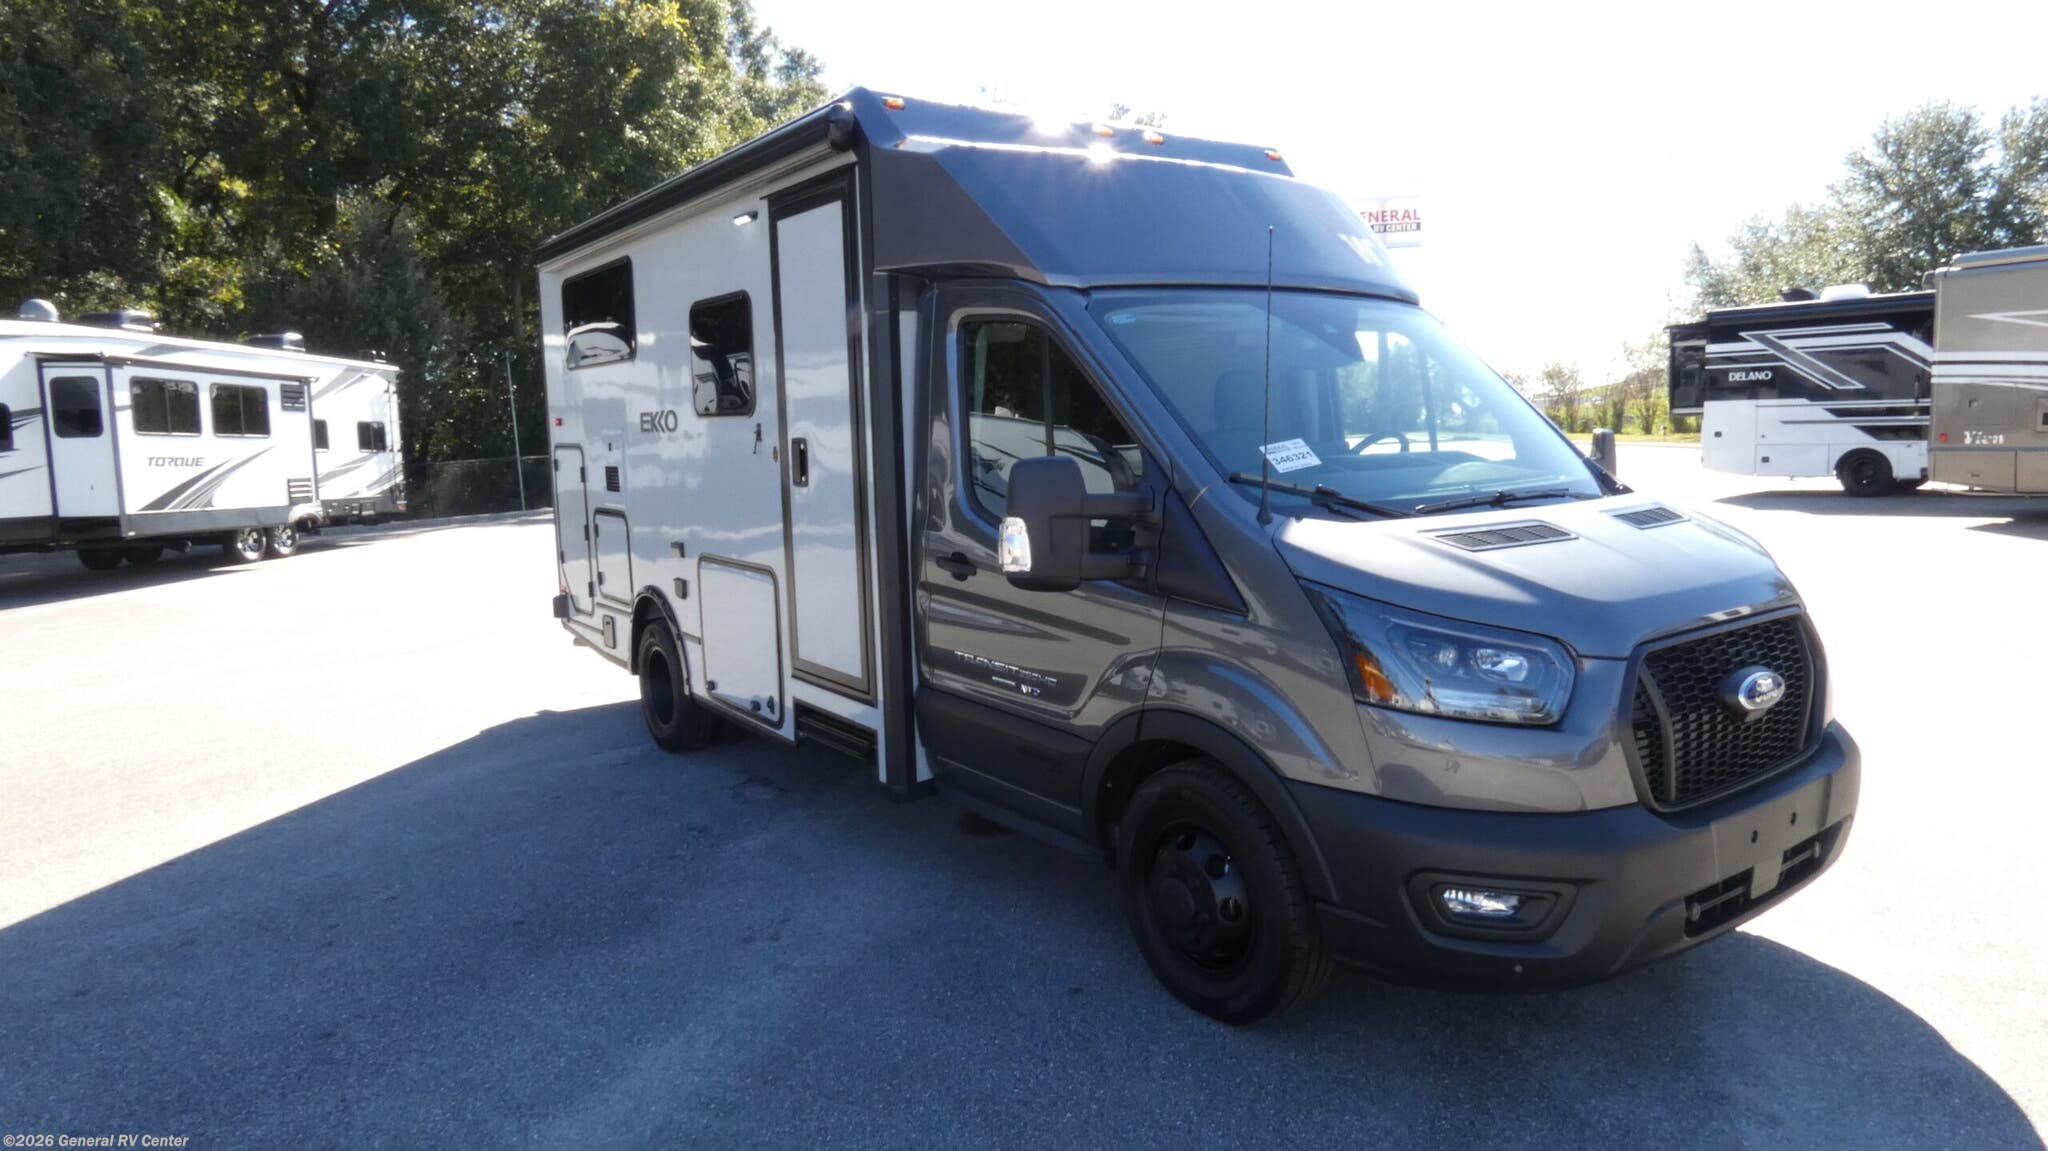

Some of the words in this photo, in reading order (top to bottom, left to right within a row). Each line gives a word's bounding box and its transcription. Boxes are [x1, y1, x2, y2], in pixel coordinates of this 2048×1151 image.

[1385, 221, 1418, 232] CENTER
[1729, 370, 1772, 382] DELANO
[640, 409, 678, 433] EKKO
[147, 456, 206, 467] TORQUE
